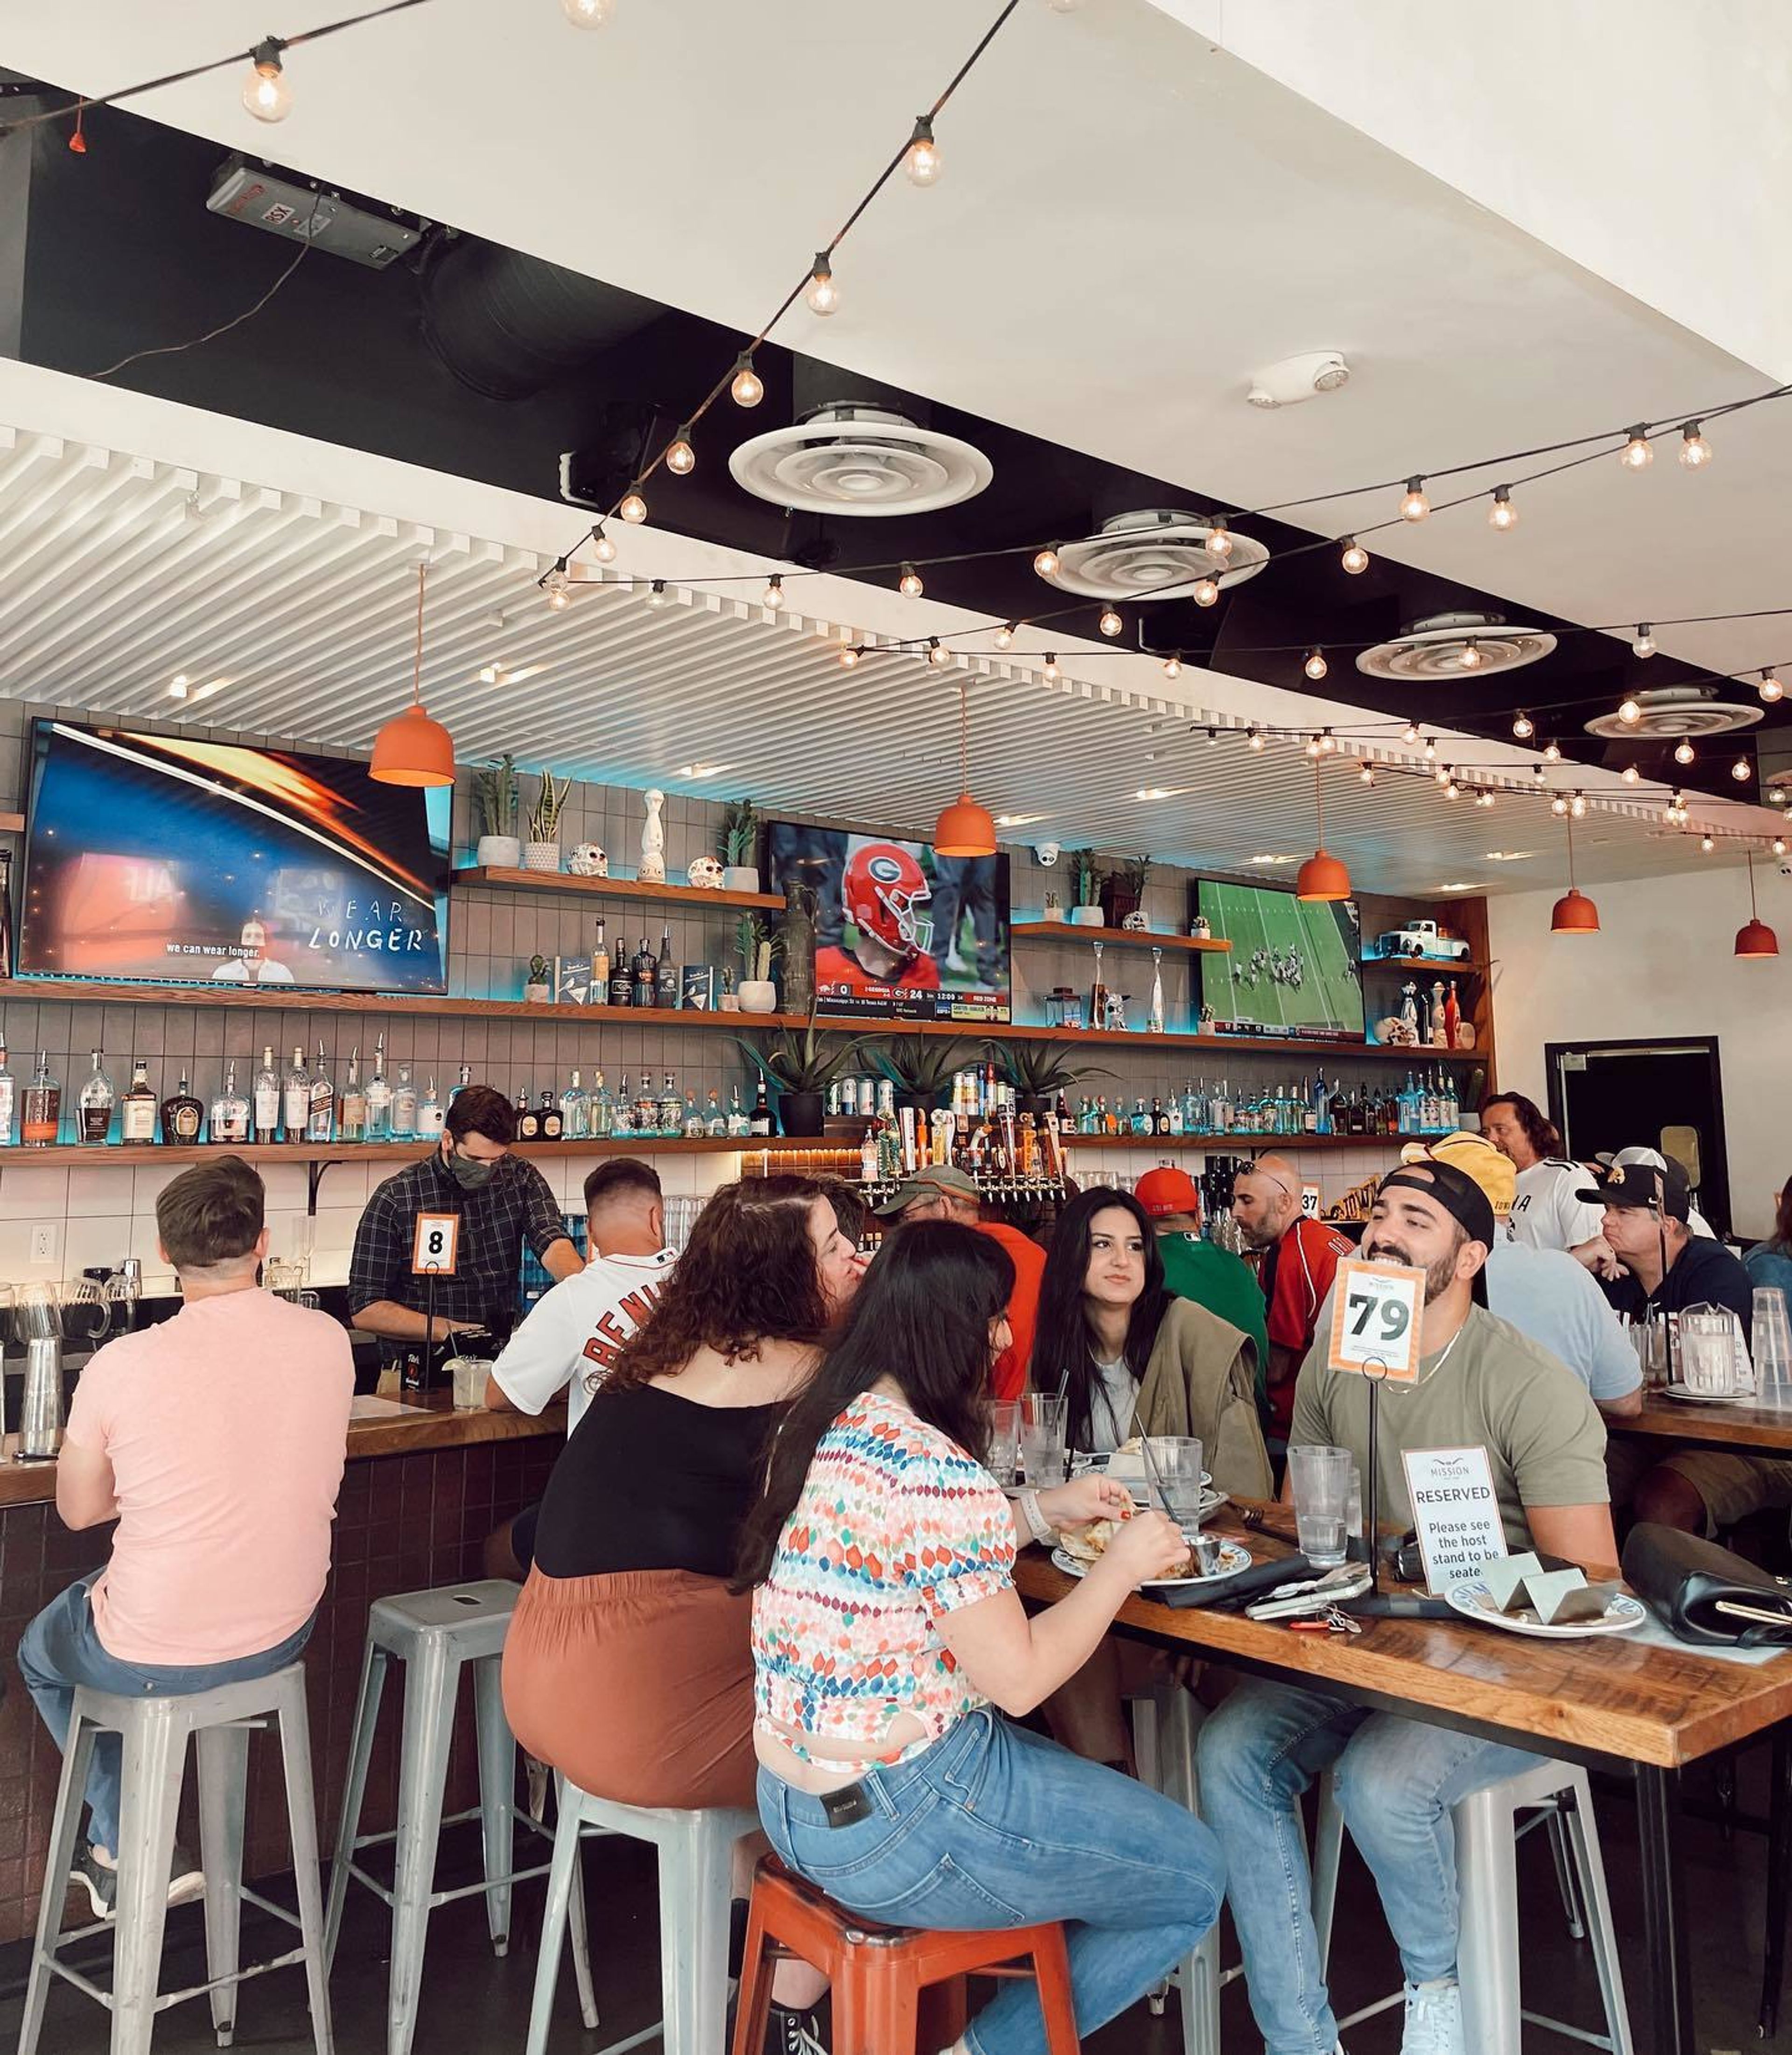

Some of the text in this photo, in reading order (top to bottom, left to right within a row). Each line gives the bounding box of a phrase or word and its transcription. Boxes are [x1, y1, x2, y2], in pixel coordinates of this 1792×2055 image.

[308, 927, 422, 951] LONGER
[167, 944, 180, 953] we
[183, 944, 200, 954] can
[203, 946, 226, 955] wear
[910, 989, 923, 999] 24
[1302, 1195, 1317, 1210] 37
[429, 1231, 443, 1254] 8
[1349, 1293, 1409, 1340] 79
[583, 1281, 672, 1368] BENI
[1431, 1467, 1470, 1477] MISSION
[1416, 1487, 1490, 1503] RESERVED
[1429, 1521, 1490, 1534] Please see
[1439, 1535, 1487, 1549] the host
[1433, 1549, 1499, 1565] stand to be
[1449, 1568, 1483, 1579] seate
